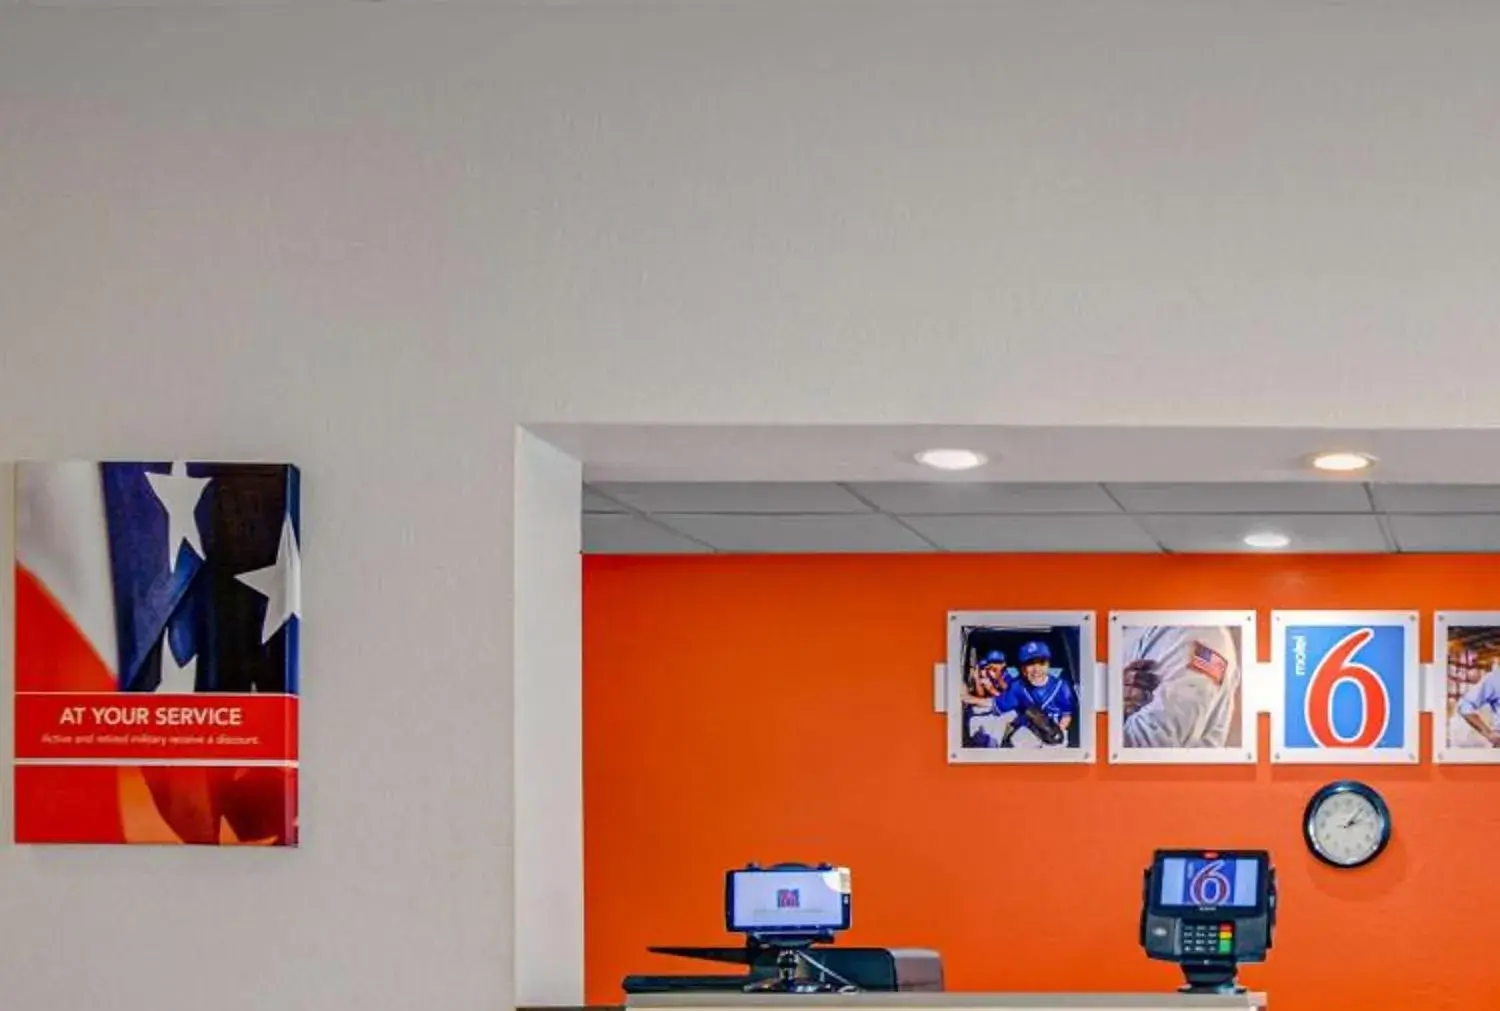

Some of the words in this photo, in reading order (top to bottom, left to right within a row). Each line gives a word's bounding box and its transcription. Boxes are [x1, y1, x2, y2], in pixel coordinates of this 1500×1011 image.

[1292, 635, 1306, 676] motel
[1304, 628, 1390, 748] 6
[59, 707, 87, 725] AT
[92, 707, 149, 725] YOUR
[155, 707, 243, 725] SERVICE
[131, 733, 167, 747] military
[1189, 859, 1231, 905] 6
